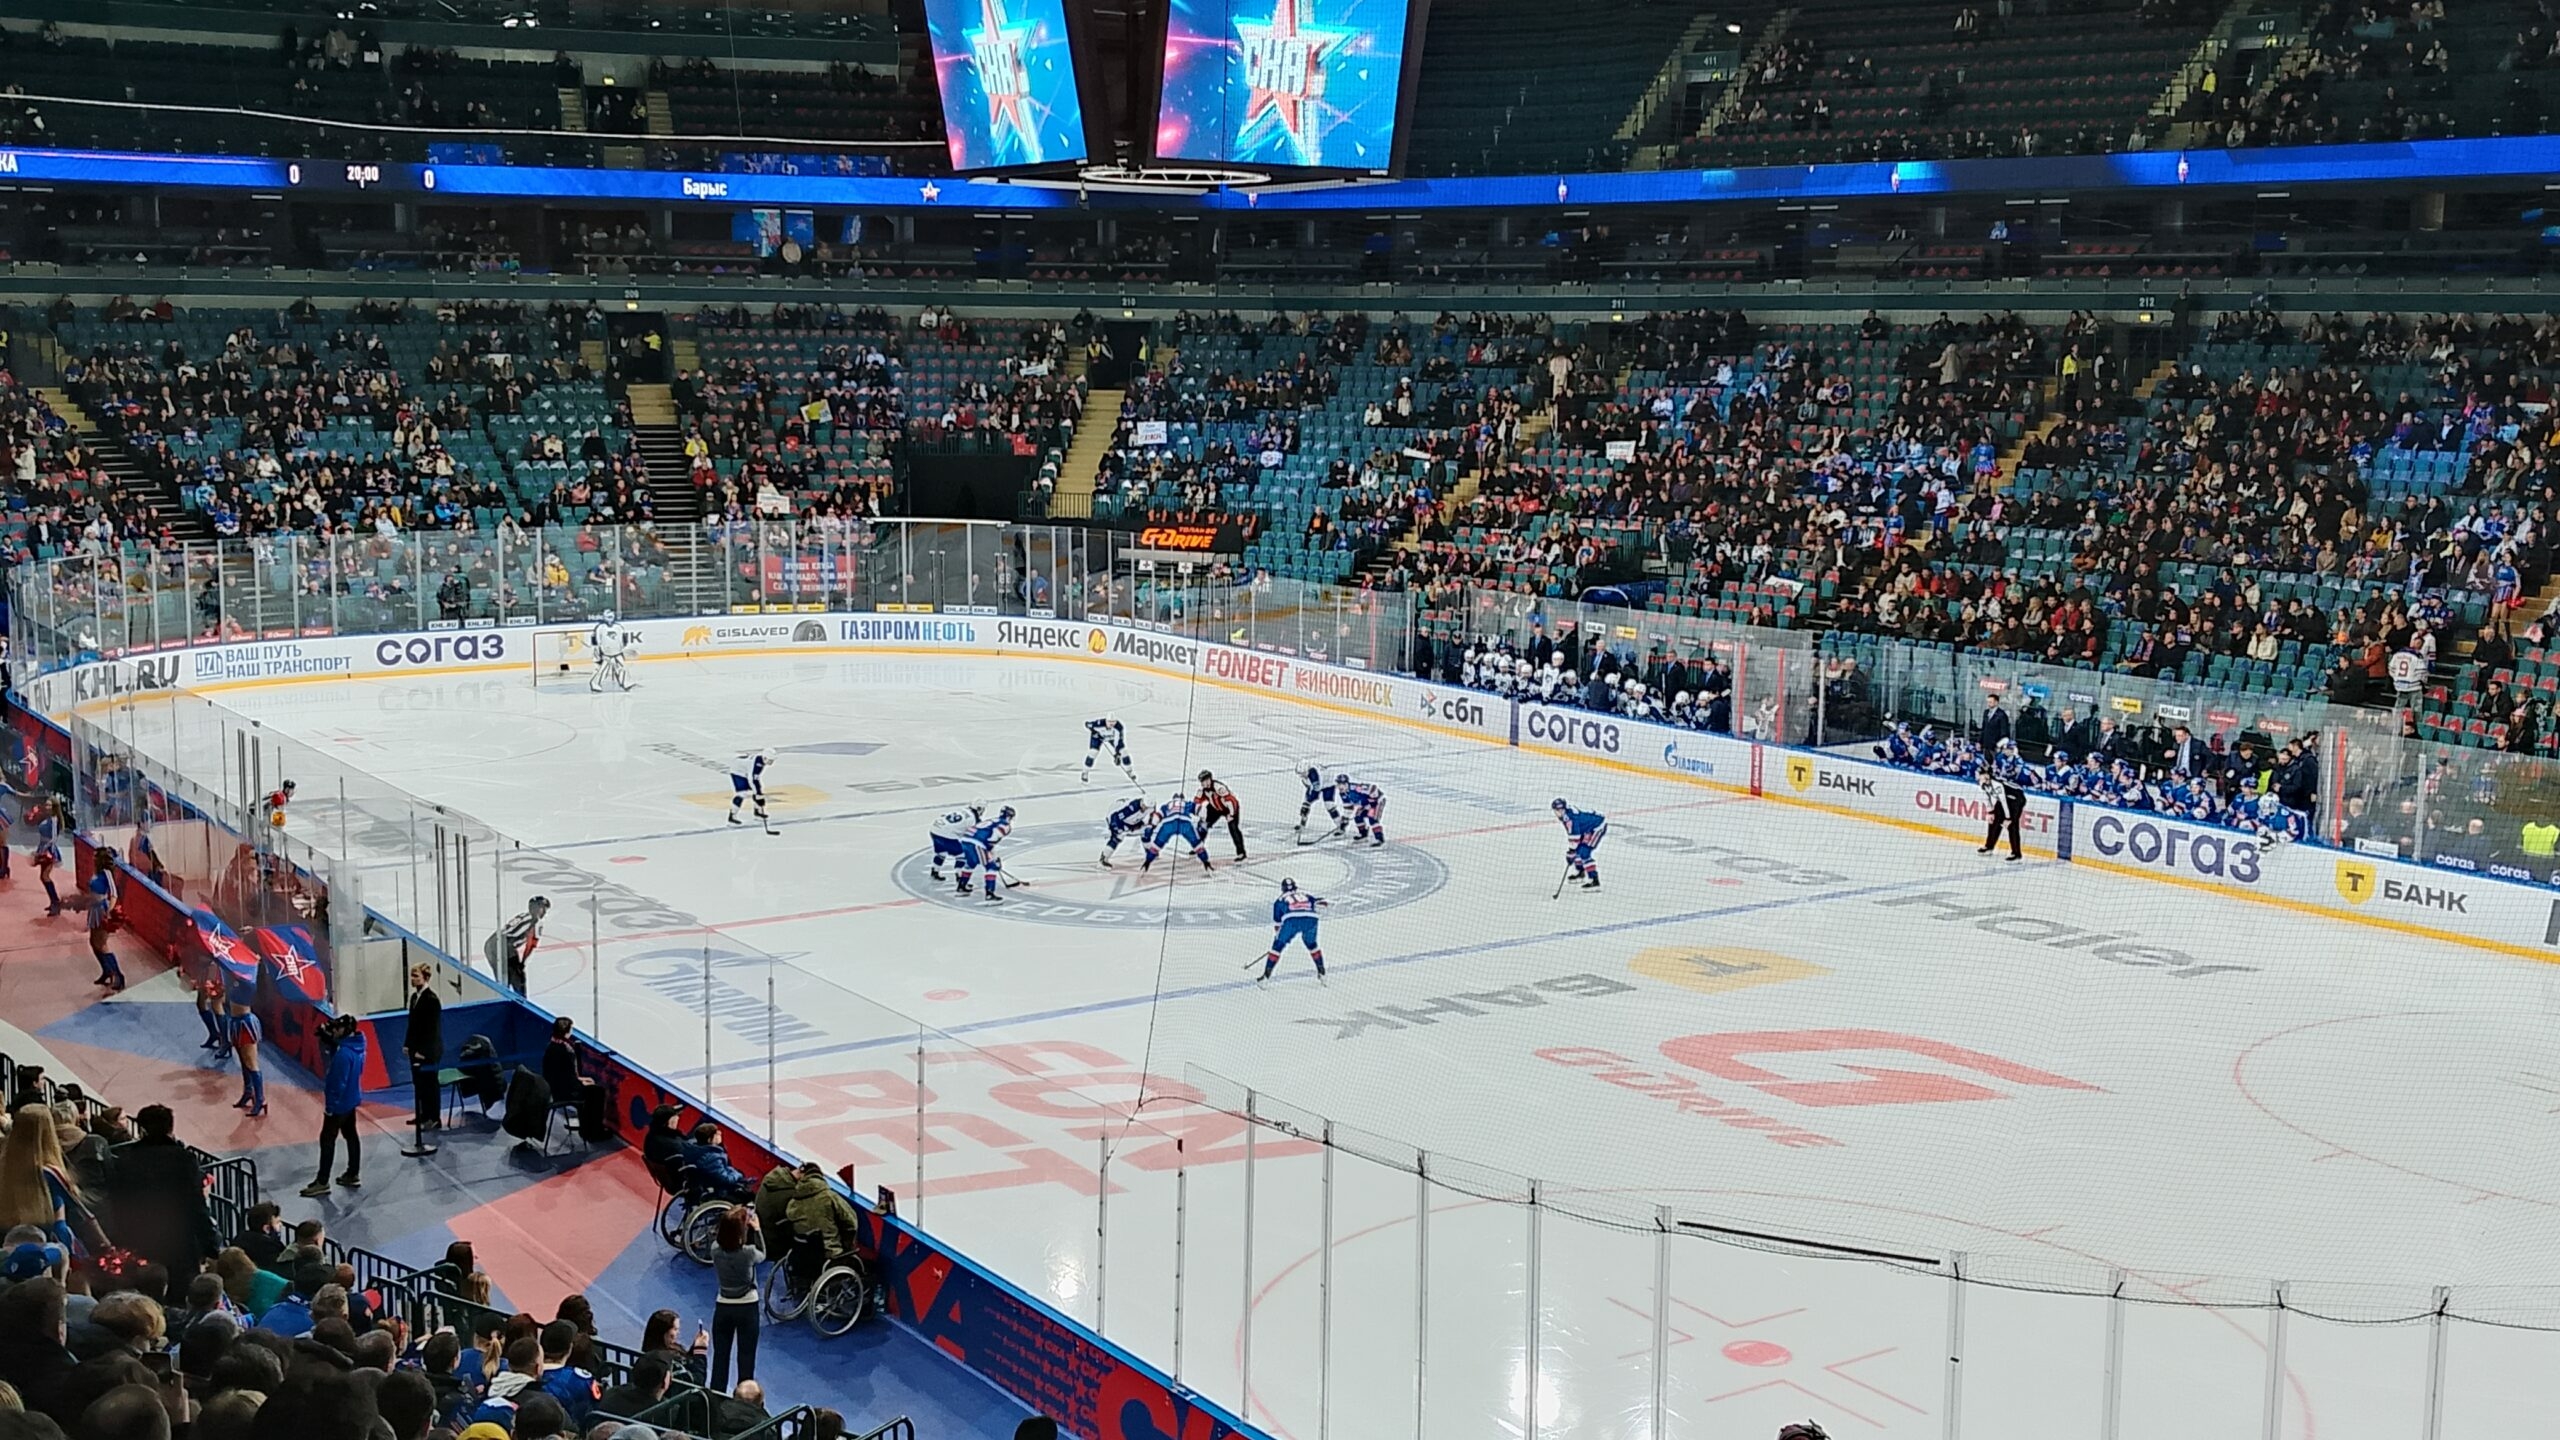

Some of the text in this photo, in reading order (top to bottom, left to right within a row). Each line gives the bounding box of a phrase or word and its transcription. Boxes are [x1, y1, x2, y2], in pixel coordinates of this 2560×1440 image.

[2257, 20, 2276, 32] 412
[1703, 55, 1719, 66] 411
[0, 153, 19, 172] КА
[347, 165, 379, 181] 20:00
[289, 164, 300, 184] 0
[424, 170, 434, 189] 0
[683, 177, 728, 200] Барыс
[1611, 299, 1627, 309] 211
[2138, 297, 2155, 308] 212
[716, 626, 789, 638] GISLAVED
[841, 620, 975, 643] ГАЗПРОМНЕФТЬ
[226, 643, 303, 663] ВАШ ПУТЬ
[997, 620, 1199, 667] Яндекс Маркет
[226, 655, 352, 679] НАШ ТРАНСПОРТ
[1204, 648, 1289, 689] FONBET
[2399, 661, 2409, 677] 9
[74, 655, 180, 703] KHL.RU
[1295, 667, 1393, 708] КИНОПОИСК
[1818, 770, 1876, 797] БАНК
[1915, 790, 2055, 833] OLIMET
[2346, 871, 2468, 914] Т БАНК
[1872, 891, 2264, 979] Haier
